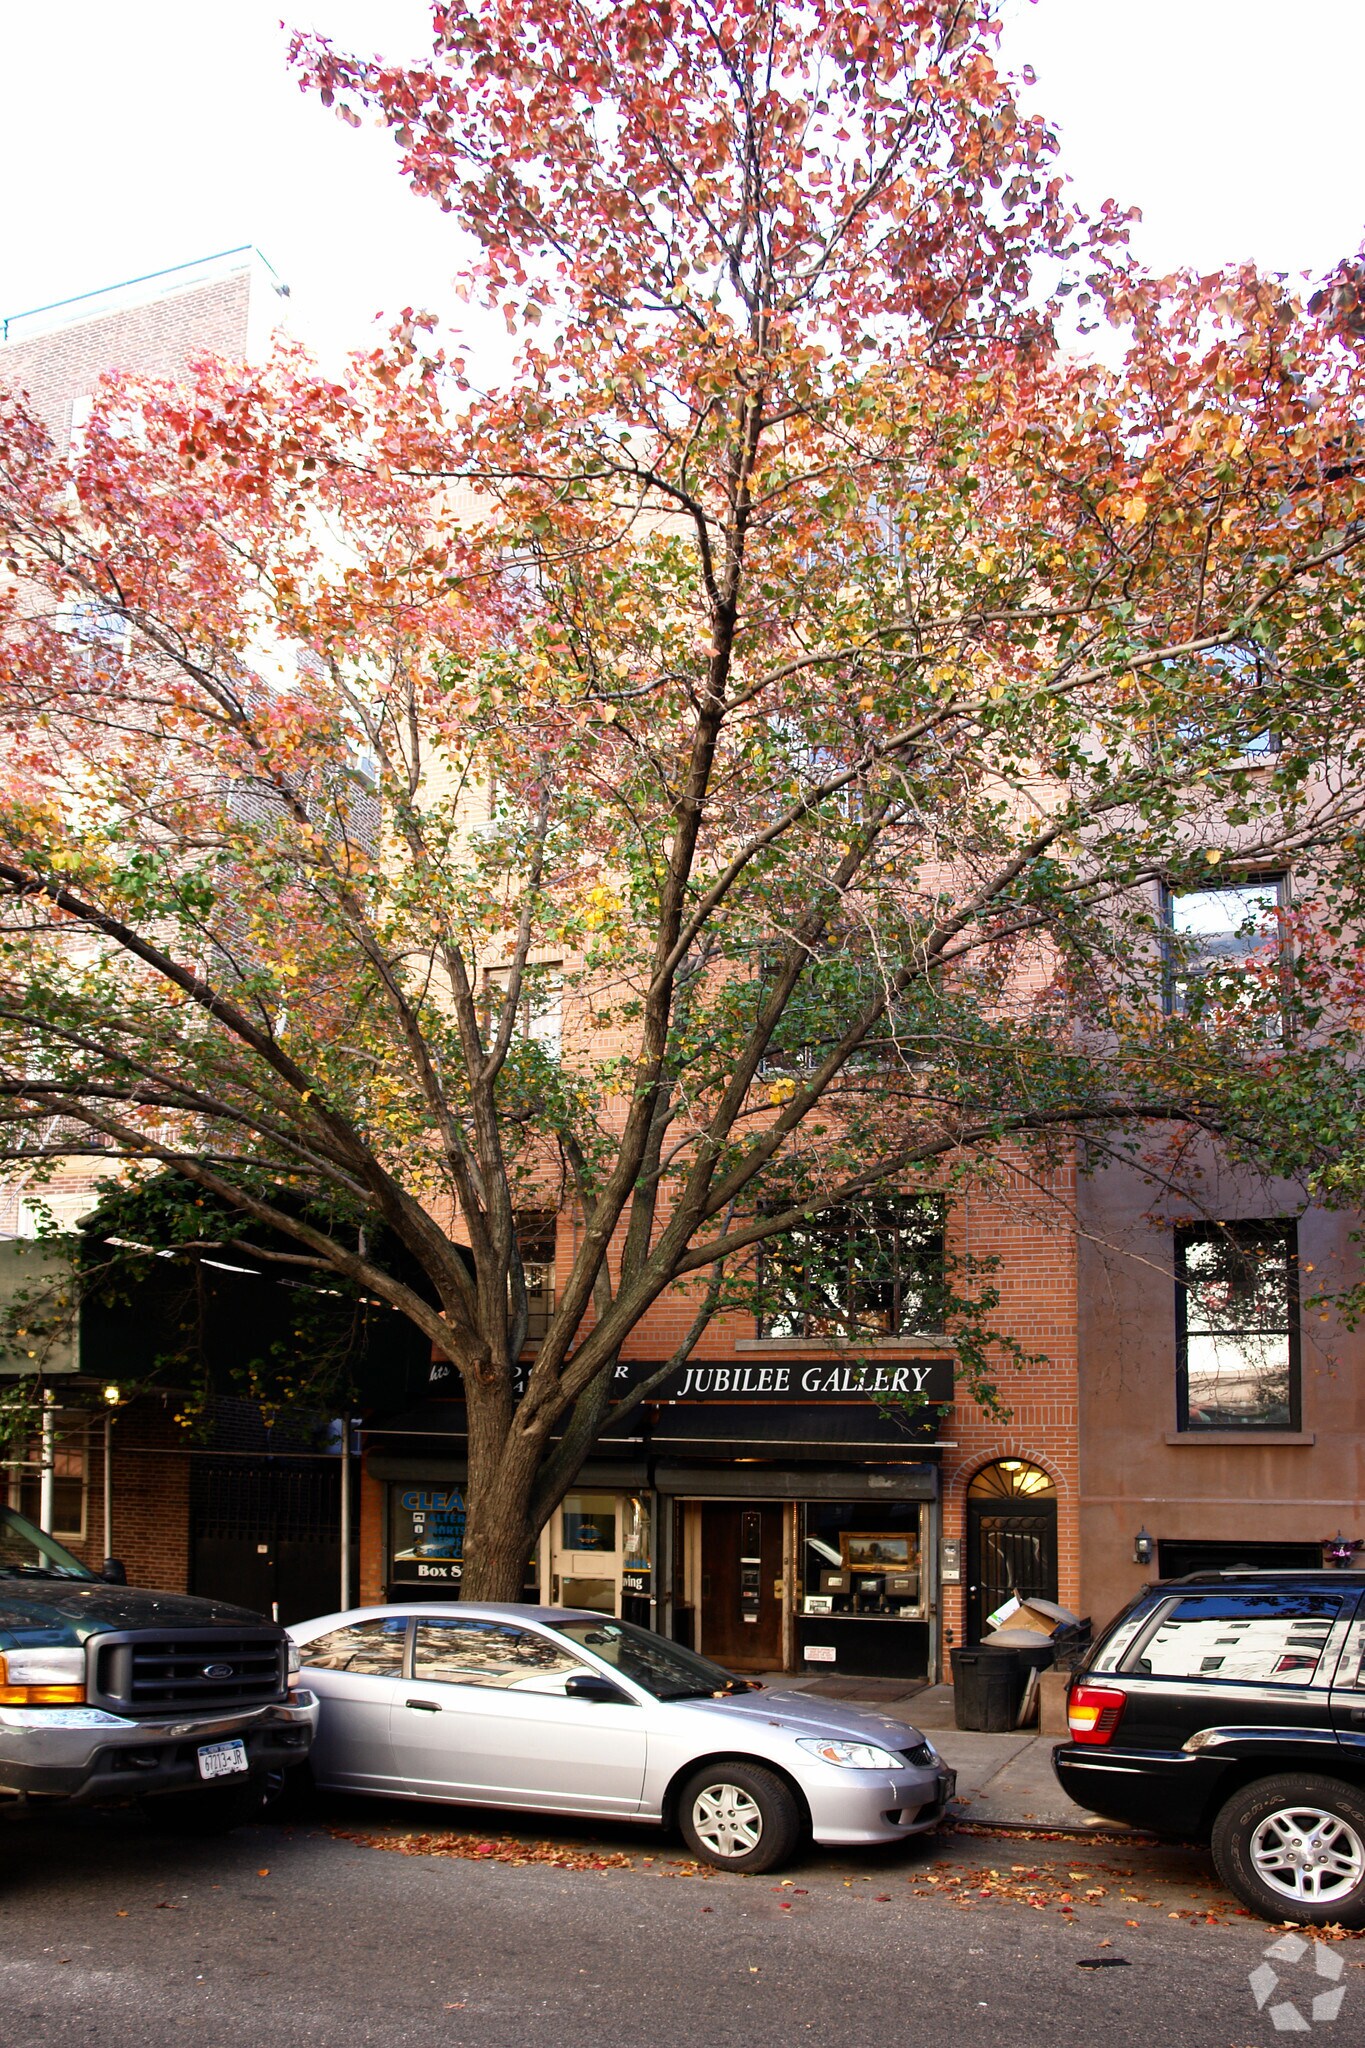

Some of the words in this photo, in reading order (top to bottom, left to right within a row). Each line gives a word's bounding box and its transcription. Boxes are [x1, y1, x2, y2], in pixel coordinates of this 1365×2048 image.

[677, 1368, 790, 1396] JUBILEE
[801, 1367, 932, 1393] GALLERY
[418, 1564, 447, 1577] Box
[450, 1565, 464, 1577] S
